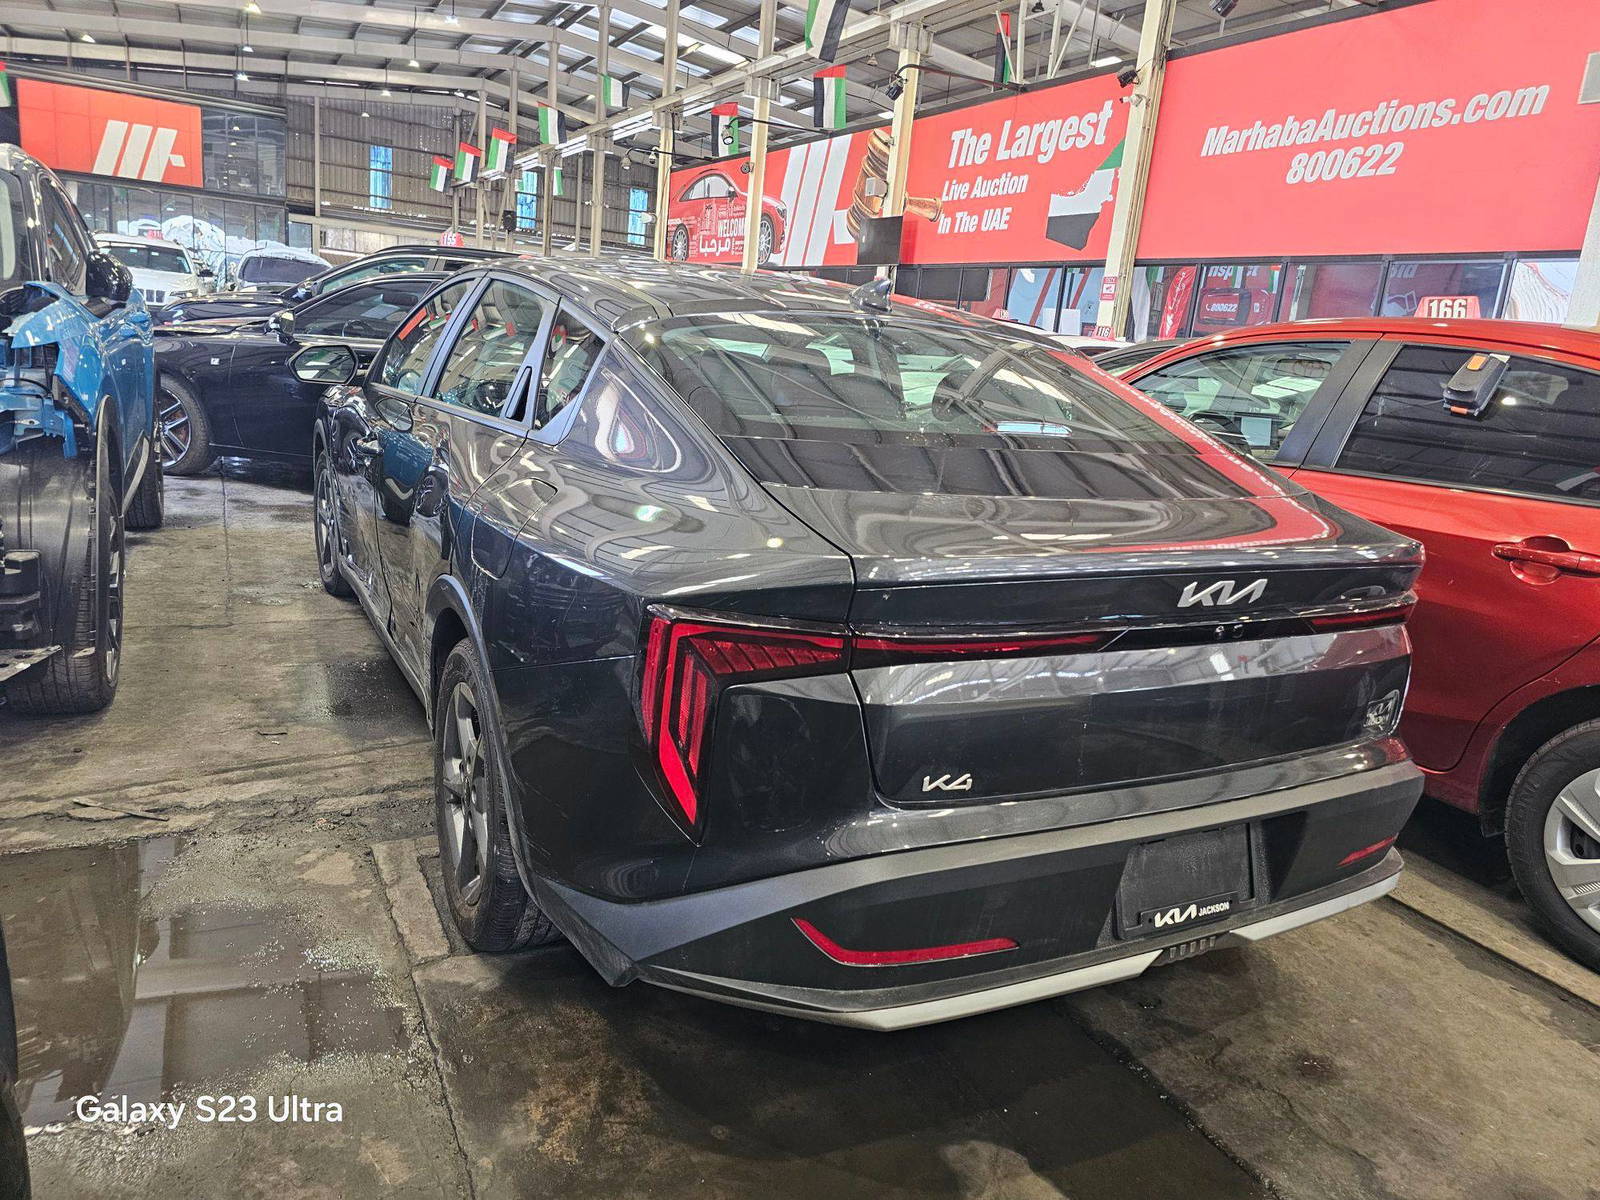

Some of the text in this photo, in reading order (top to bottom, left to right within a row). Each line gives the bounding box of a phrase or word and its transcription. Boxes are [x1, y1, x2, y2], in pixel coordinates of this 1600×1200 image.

[948, 100, 1114, 169] The Largest
[1199, 84, 1551, 158] MarhabaAuctions.com
[1286, 141, 1405, 185] 800622
[942, 171, 1030, 202] Live Auction
[718, 217, 745, 238] WELCOM
[937, 206, 1013, 235] In The UAE
[1428, 298, 1468, 319] 166
[1176, 578, 1268, 608] KIA
[922, 773, 973, 792] K4
[1154, 901, 1230, 928] KIA JACKSON
